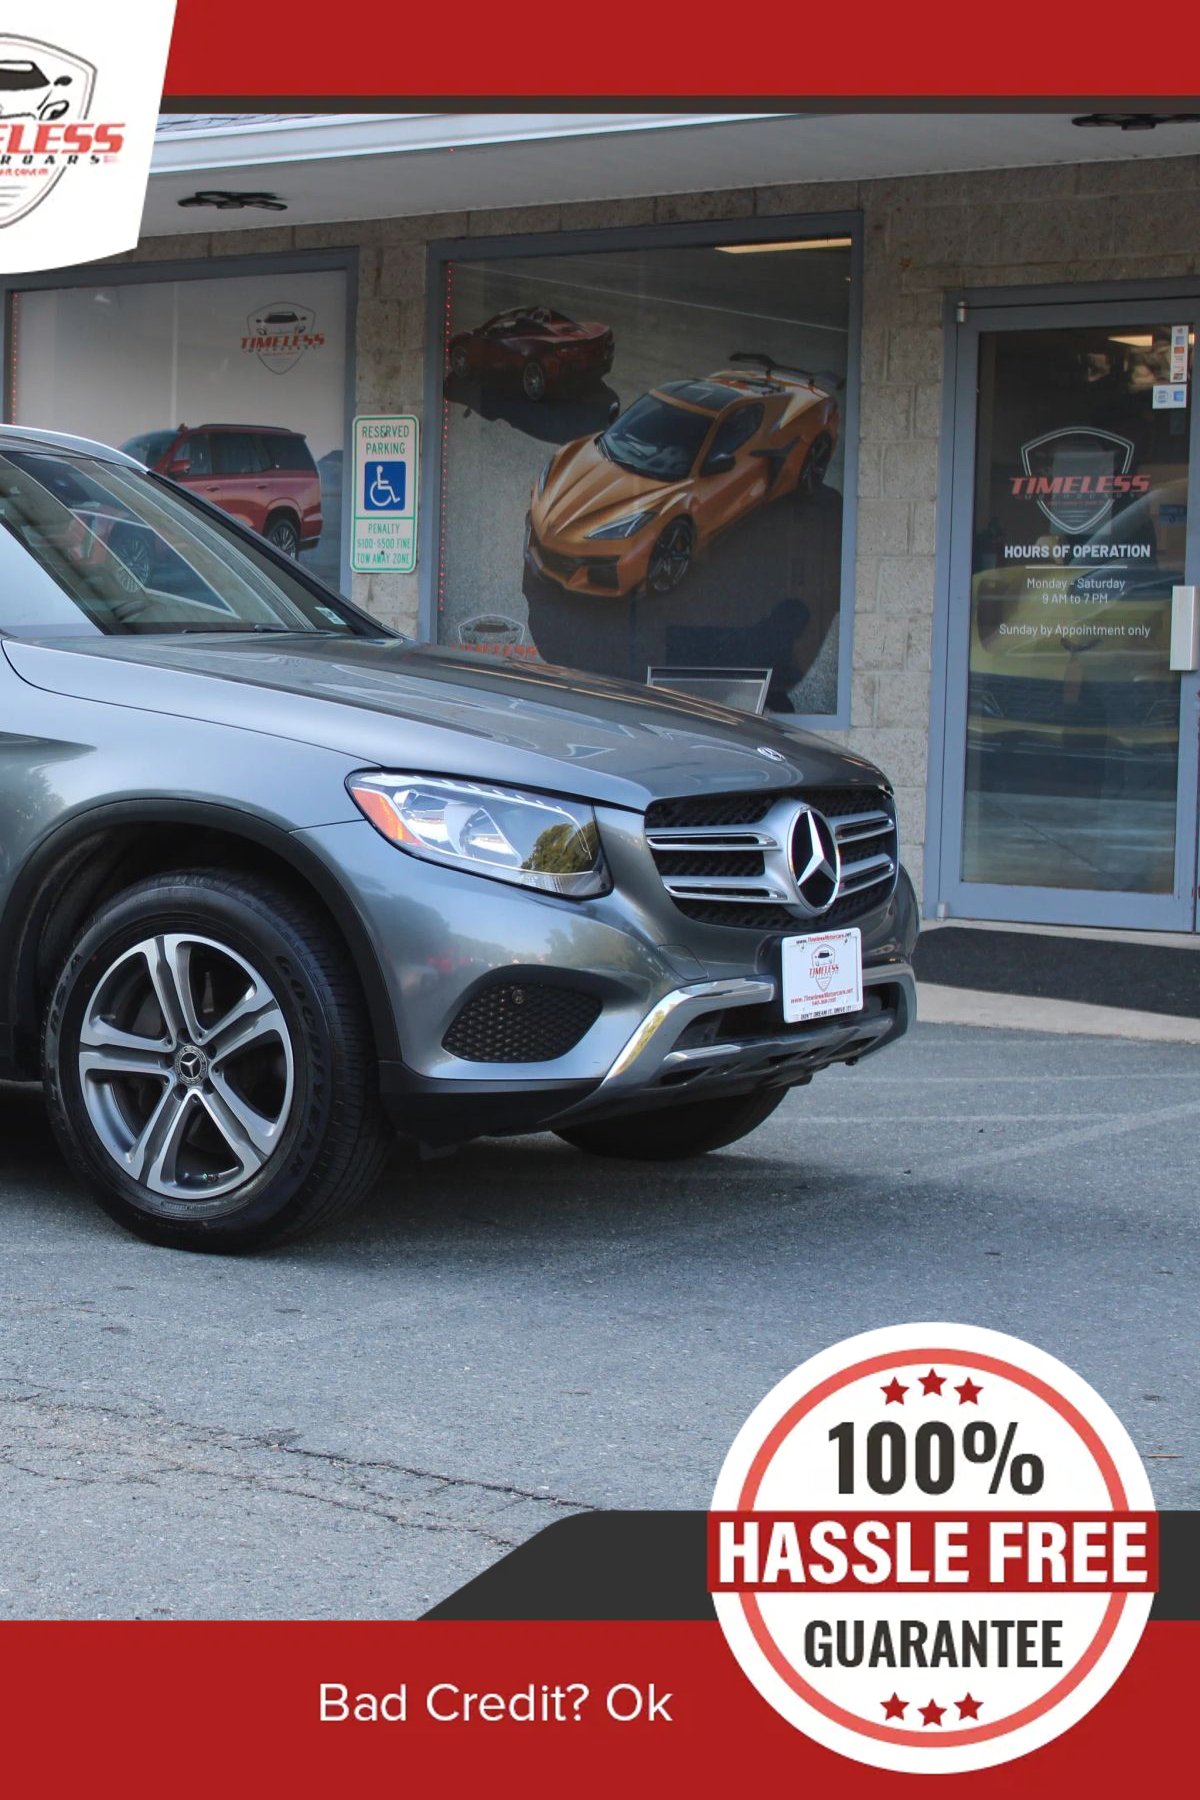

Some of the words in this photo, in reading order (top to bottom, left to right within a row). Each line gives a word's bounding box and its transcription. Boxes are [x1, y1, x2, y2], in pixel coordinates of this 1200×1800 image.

[241, 334, 325, 349] TIMELESS
[362, 425, 410, 438] RESERVED
[366, 442, 406, 455] PARKING
[1010, 474, 1152, 494] TIMELESS
[368, 523, 400, 534] PENALTY
[1004, 545, 1049, 558] HOURS
[1052, 545, 1070, 558] OF
[1073, 544, 1151, 558] OPERATION
[357, 553, 371, 564] TOW
[1026, 578, 1068, 591] Monday
[1077, 578, 1126, 591] Saturday
[1042, 593, 1048, 604] 9
[1052, 593, 1067, 604] AM
[1070, 593, 1081, 604] to
[1083, 593, 1089, 604] 7
[1092, 593, 1108, 604] PM
[999, 624, 1039, 638] Sunday
[1040, 624, 1055, 638] by
[1054, 624, 1126, 638] Appointment
[1128, 625, 1151, 638] only
